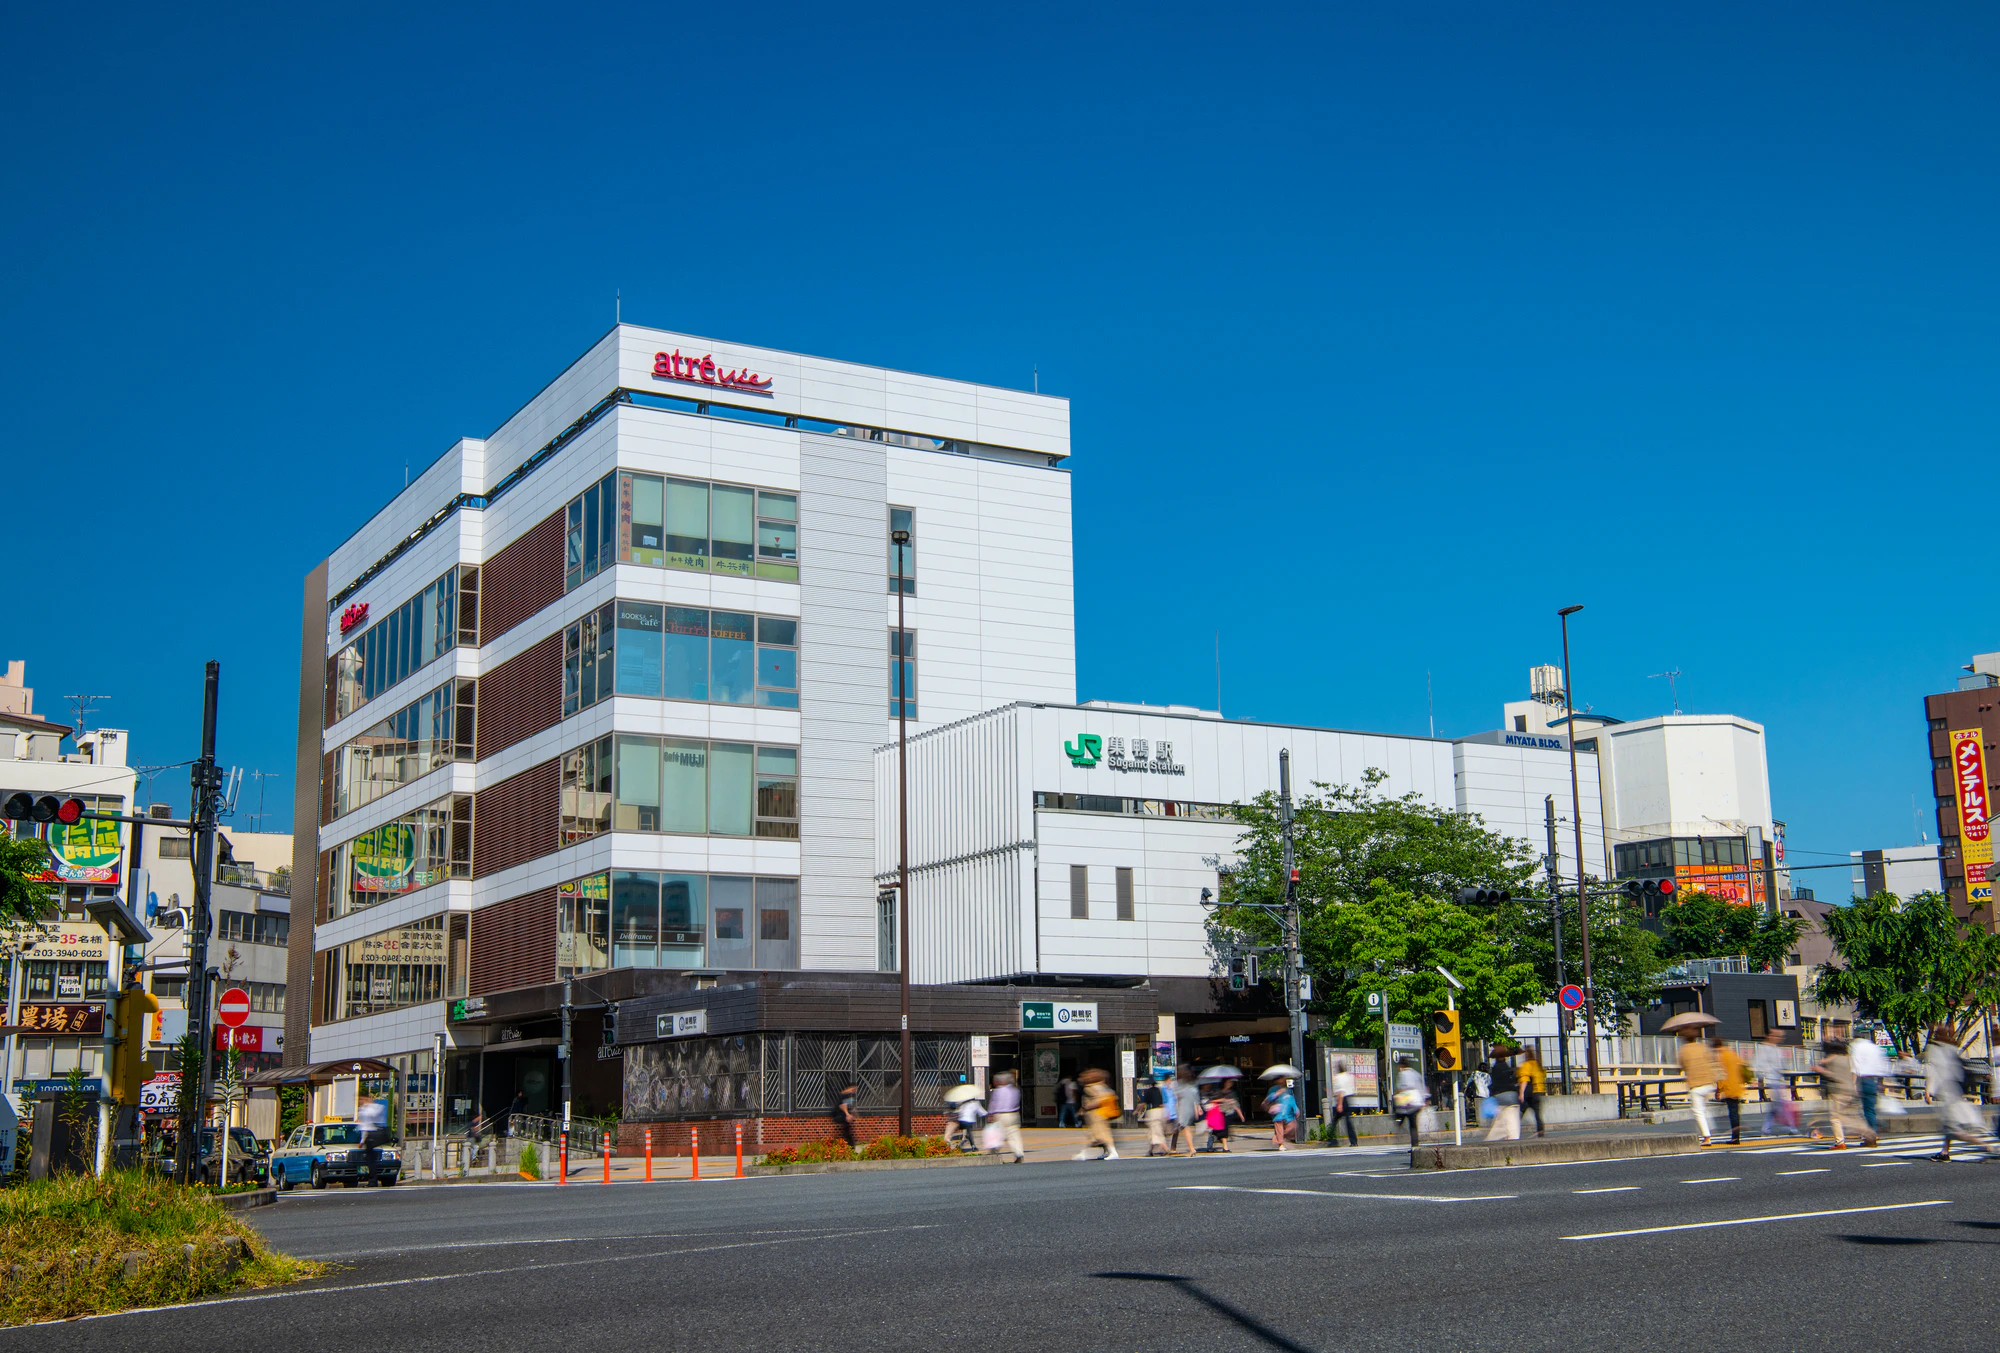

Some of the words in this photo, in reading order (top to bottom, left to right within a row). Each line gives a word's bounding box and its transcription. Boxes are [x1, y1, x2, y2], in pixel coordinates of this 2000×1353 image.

[1064, 733, 1102, 758] JR
[1108, 736, 1173, 759] 巣鴨駅
[1506, 735, 1537, 746] MIYATA
[1538, 738, 1562, 749] BLDG.
[680, 753, 704, 768] MUJI
[1109, 757, 1148, 772] Sugamo
[1149, 760, 1185, 774] Station
[1959, 742, 1986, 823] メンテルス
[222, 1032, 257, 1046] ちい飲み
